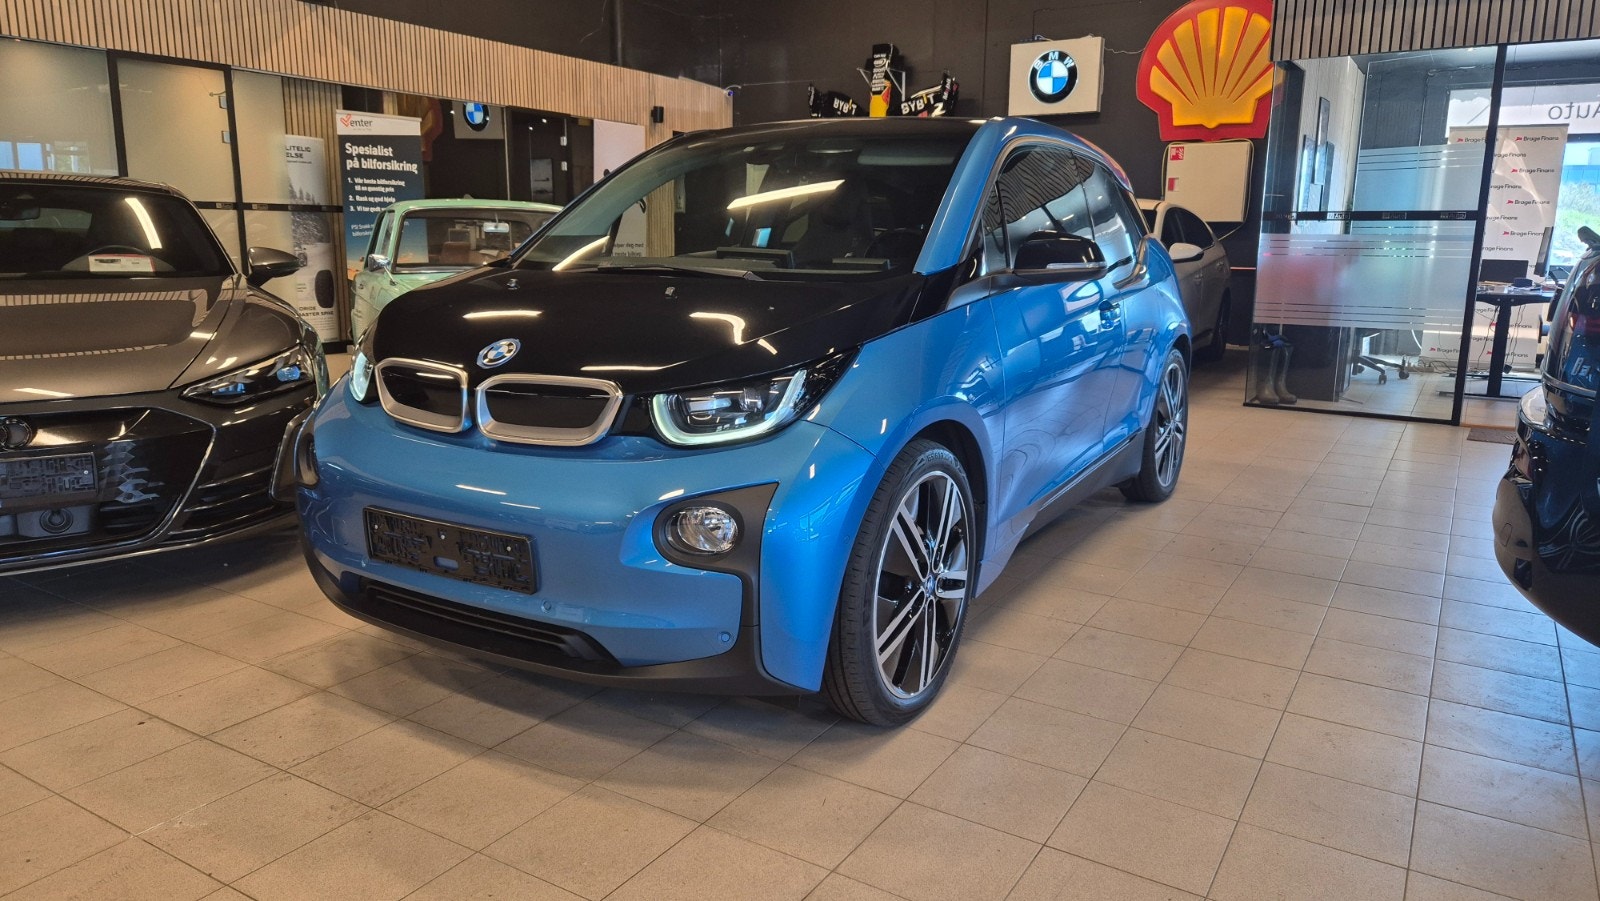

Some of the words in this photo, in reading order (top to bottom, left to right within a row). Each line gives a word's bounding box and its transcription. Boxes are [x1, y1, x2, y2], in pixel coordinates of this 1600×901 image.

[1033, 51, 1075, 70] BMW
[833, 97, 857, 115] BYBIT
[901, 94, 935, 115] BYBIT
[345, 142, 393, 157] Spesialist
[346, 158, 359, 170] på
[361, 157, 418, 174] bilforsikring
